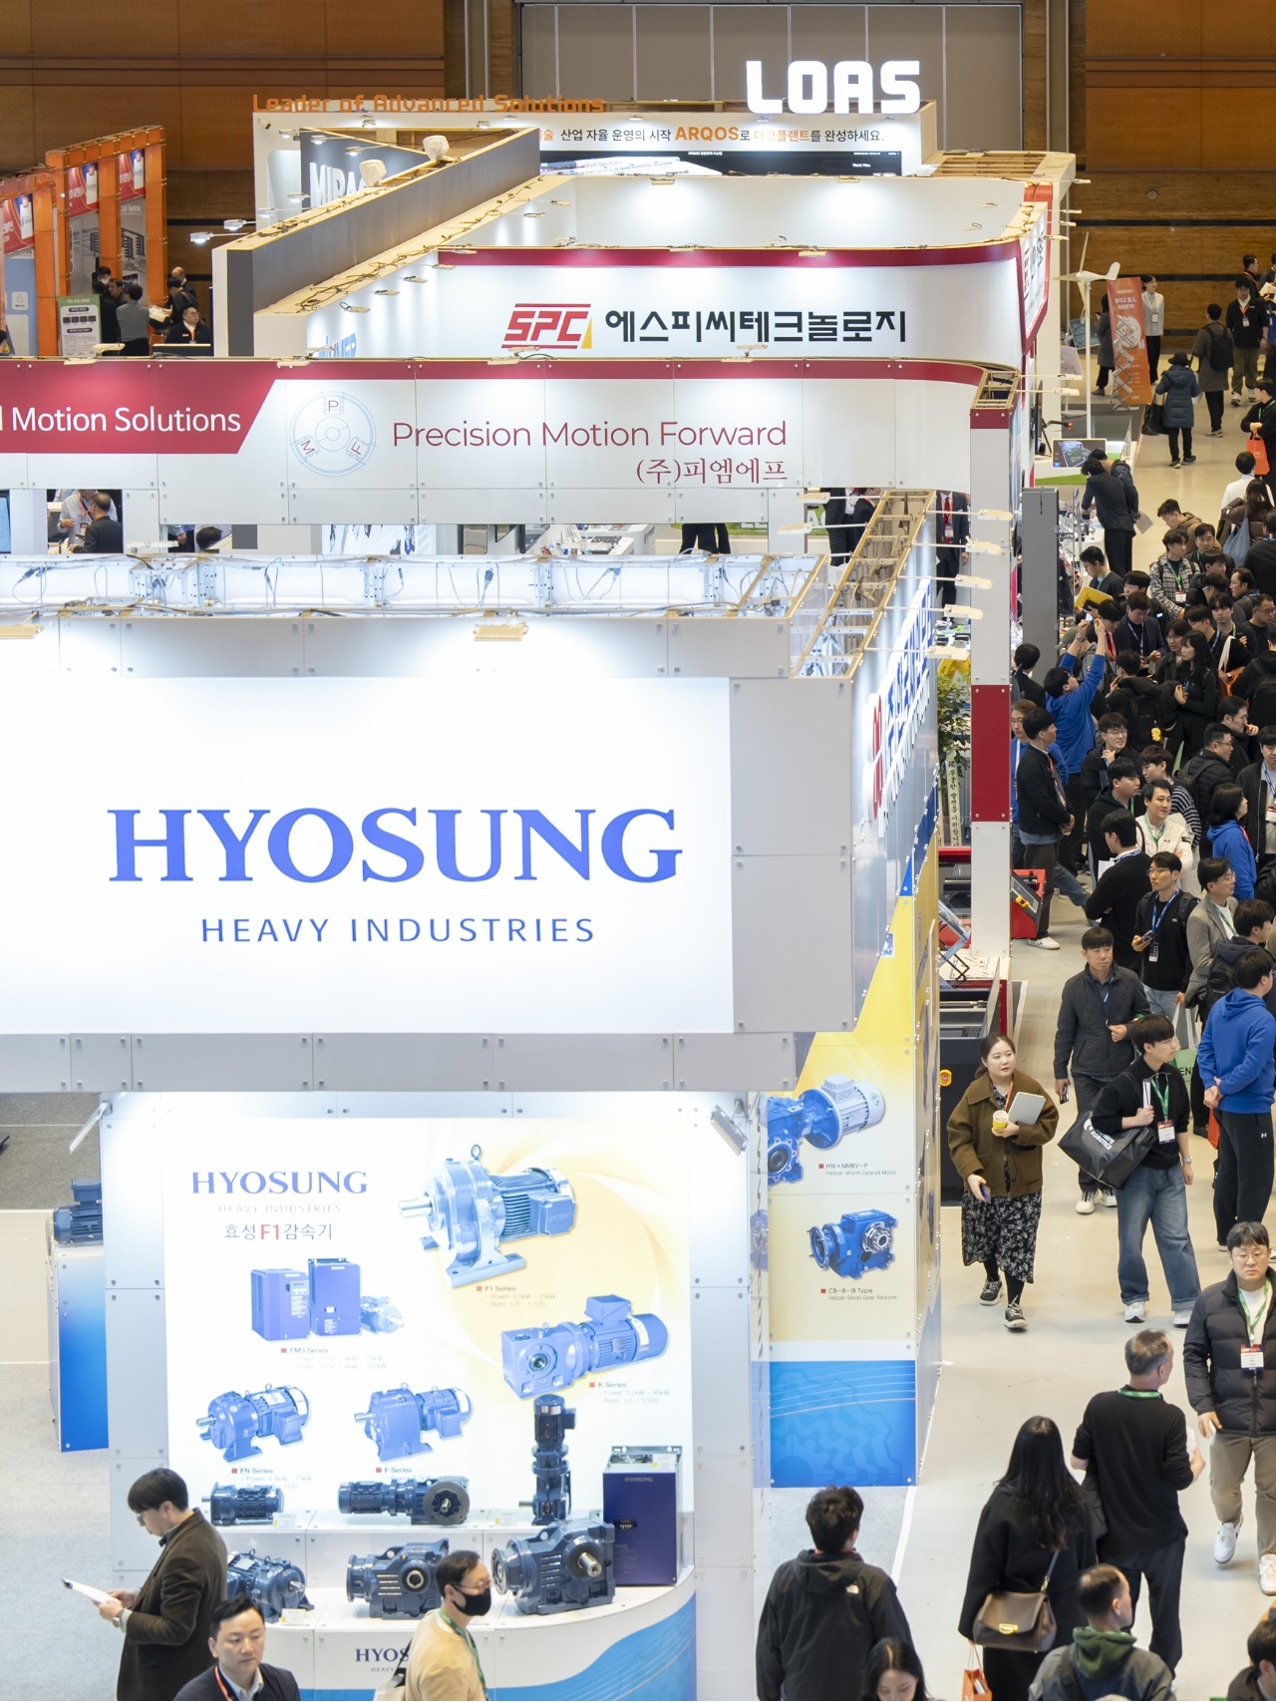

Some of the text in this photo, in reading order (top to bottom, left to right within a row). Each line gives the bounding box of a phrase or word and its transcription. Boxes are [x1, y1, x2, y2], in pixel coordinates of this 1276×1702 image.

[745, 60, 921, 115] LOAS
[252, 94, 605, 113] Leader of Advanced Solutions
[560, 128, 583, 142] 산업
[586, 128, 609, 142] 자율
[611, 128, 646, 142] 운영의
[649, 128, 672, 142] 시작
[824, 129, 884, 143] 완성하세요.
[502, 309, 906, 344] SPC 에스피씨테크놀로지
[12, 405, 107, 433] Motion
[114, 405, 242, 433] Solutions
[392, 420, 788, 447] Precision Motion Forward
[636, 457, 788, 485] (주)피엠에프
[107, 807, 683, 884] HYOSUNG
[201, 918, 595, 942] HEAVY INDUSTRIES
[191, 1170, 369, 1195] HYOSUNG
[218, 1204, 342, 1213] HEAVY INDUSTRIES
[355, 1648, 409, 1662] HYOS
